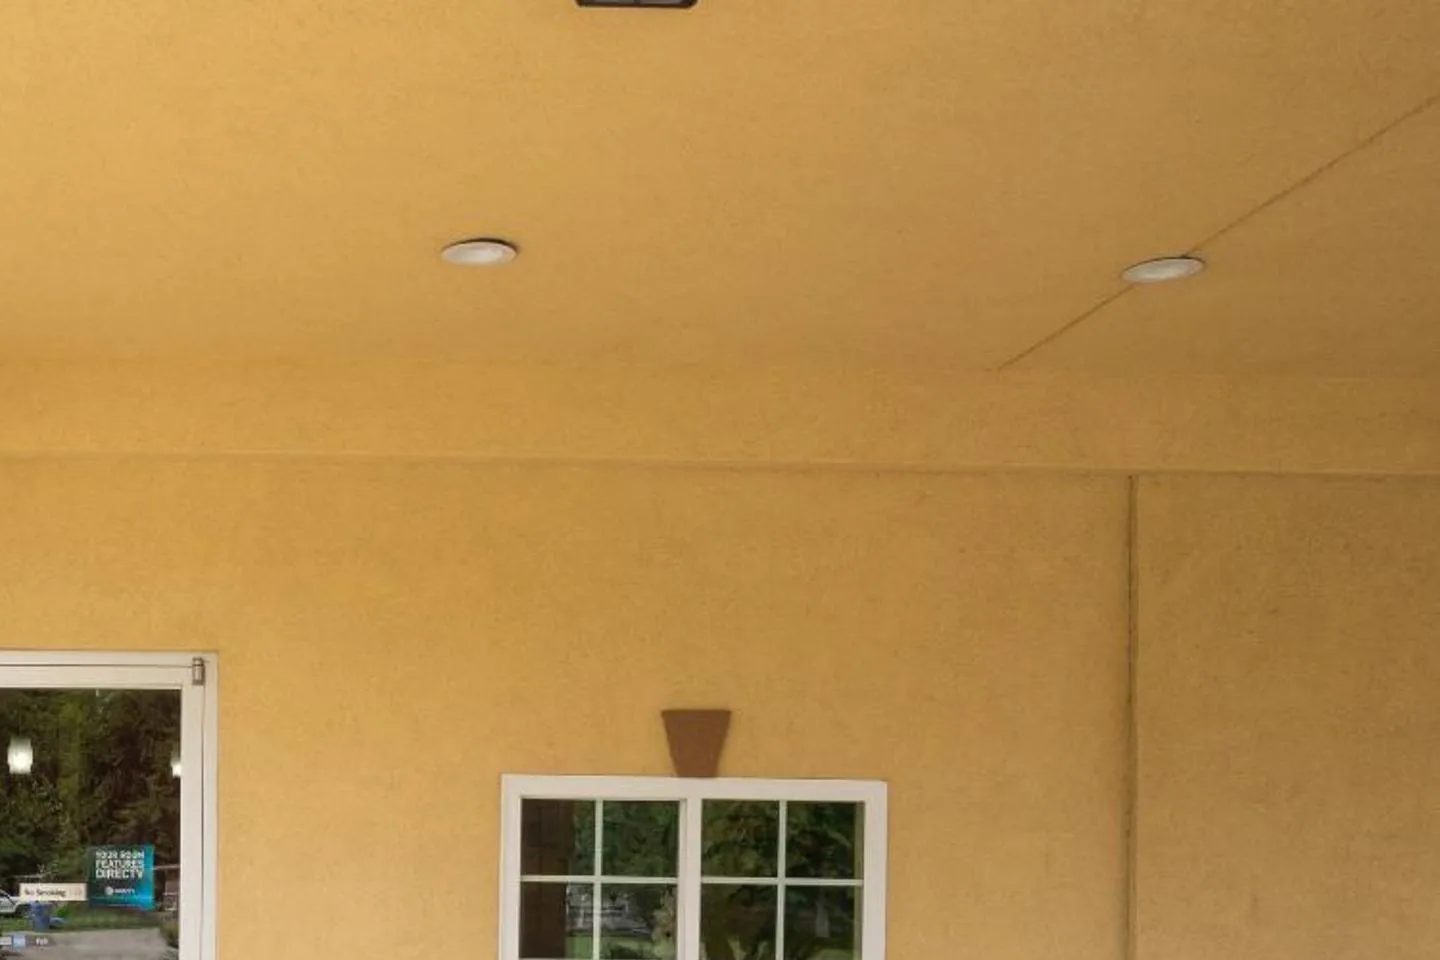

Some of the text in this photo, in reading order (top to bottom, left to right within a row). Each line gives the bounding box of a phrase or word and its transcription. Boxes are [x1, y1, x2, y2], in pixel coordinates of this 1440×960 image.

[95, 859, 145, 869] FEATURES
[95, 869, 144, 879] DIRECTV
[36, 887, 67, 898] Smoking
